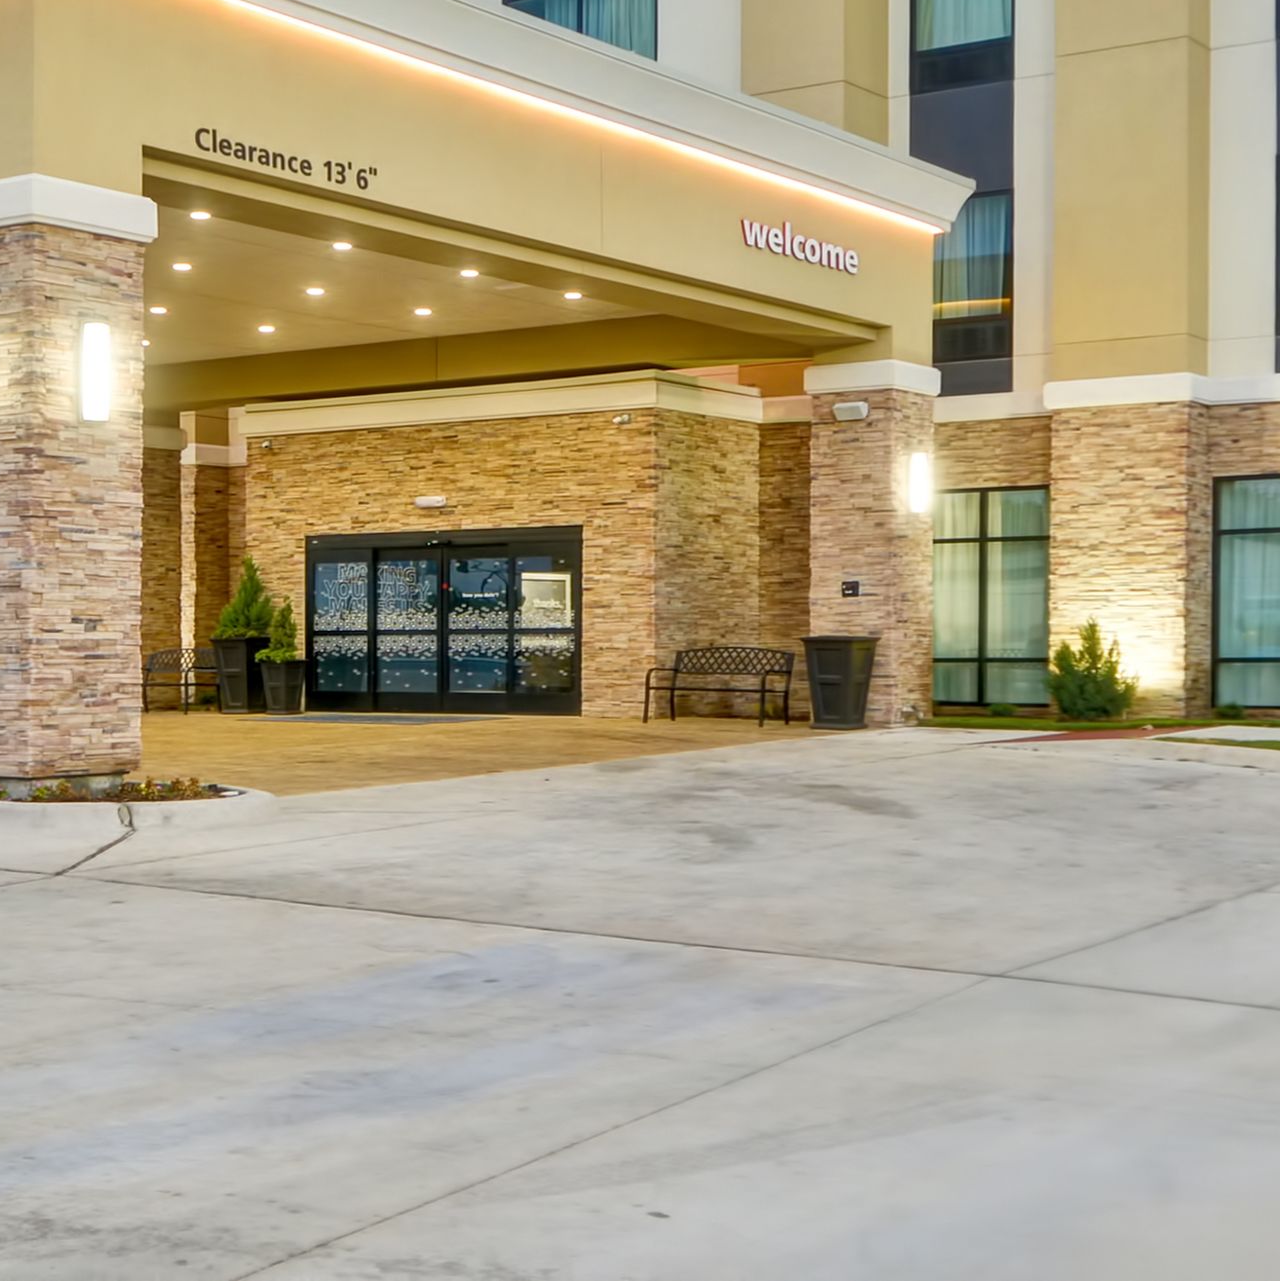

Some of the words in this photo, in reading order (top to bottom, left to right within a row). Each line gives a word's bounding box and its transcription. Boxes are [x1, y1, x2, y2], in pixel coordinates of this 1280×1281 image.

[194, 127, 313, 177] Clearance
[740, 218, 859, 275] welcome
[323, 579, 368, 600] YOU
